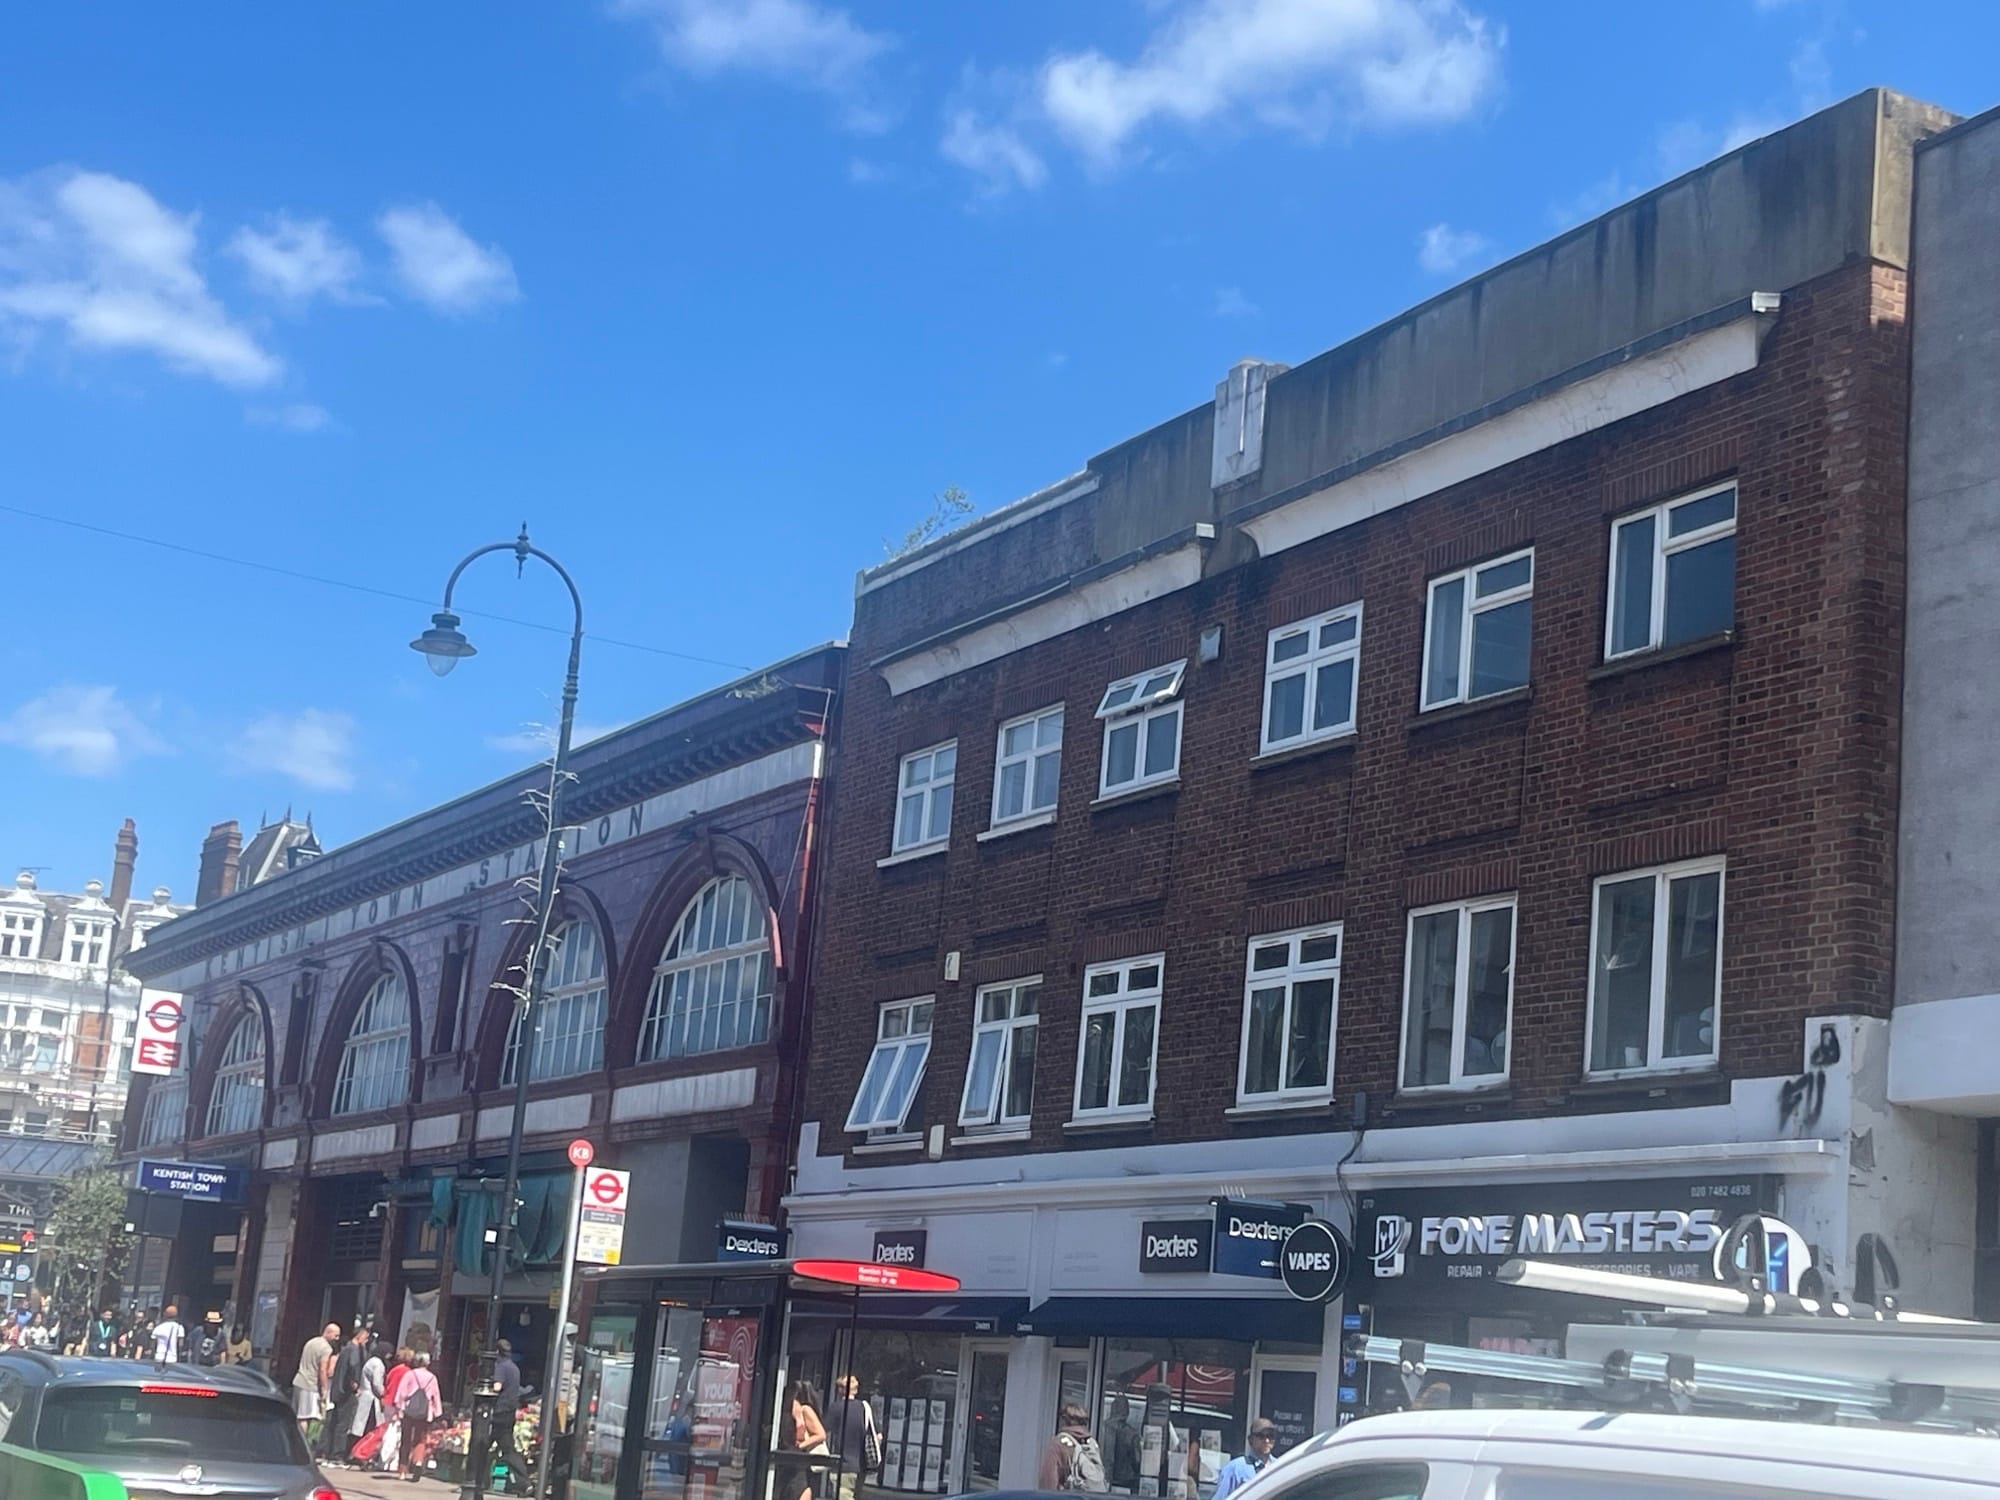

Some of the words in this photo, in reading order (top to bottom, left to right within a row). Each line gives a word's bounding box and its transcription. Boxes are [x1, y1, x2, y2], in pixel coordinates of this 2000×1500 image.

[204, 925, 307, 980] KENTISH
[351, 882, 424, 931] TOWN
[478, 803, 643, 886] STAION
[153, 1168, 193, 1180] KENTISH
[197, 1172, 227, 1183] TOWN
[169, 1180, 210, 1192] STATION
[1229, 1217, 1294, 1241] Dexters
[1420, 1215, 1515, 1255] FONE
[1517, 1209, 1723, 1254] MASTERS
[725, 1235, 778, 1255] Dexters
[876, 1243, 914, 1263] Dexters
[1146, 1235, 1199, 1259] Dexters
[1288, 1252, 1331, 1271] VAPES
[1447, 1265, 1483, 1278] REPAIR
[1669, 1264, 1699, 1277] VAPE
